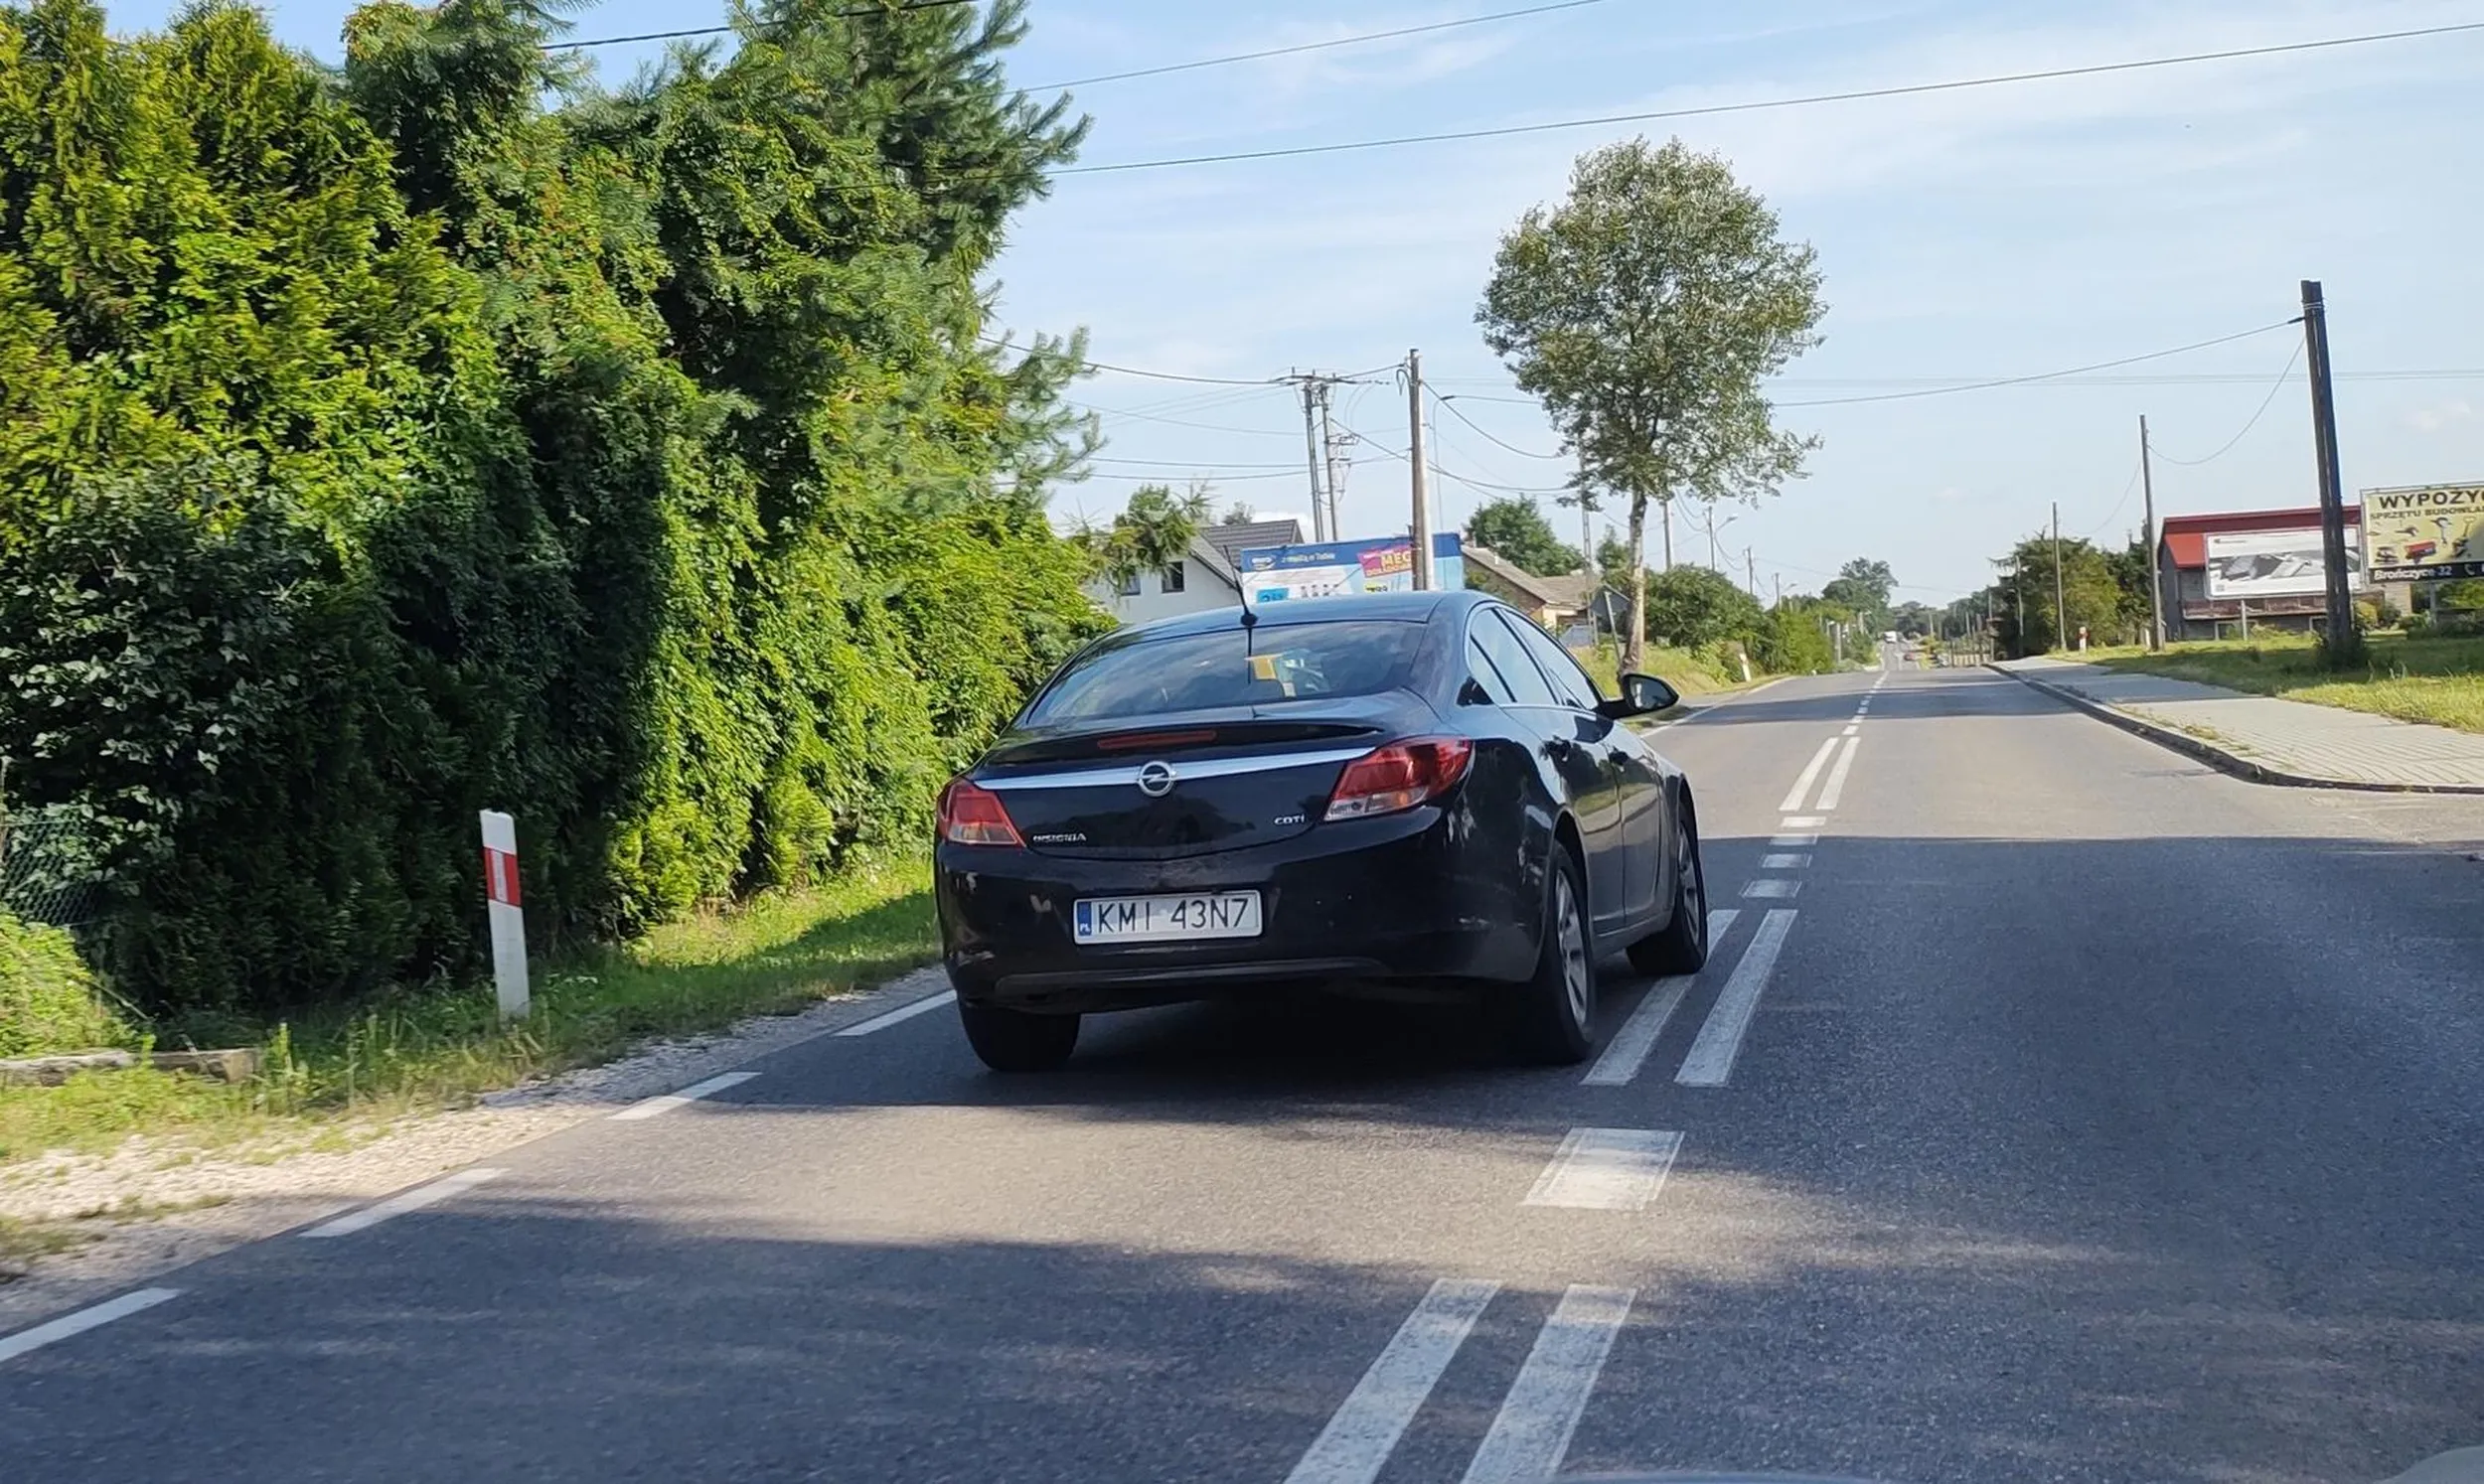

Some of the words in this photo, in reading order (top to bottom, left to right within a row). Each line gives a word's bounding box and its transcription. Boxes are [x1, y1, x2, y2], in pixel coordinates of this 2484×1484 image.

[2424, 506, 2484, 517] BUDOWLA
[1098, 901, 1151, 934] KMI
[1170, 898, 1249, 930] 43N7
